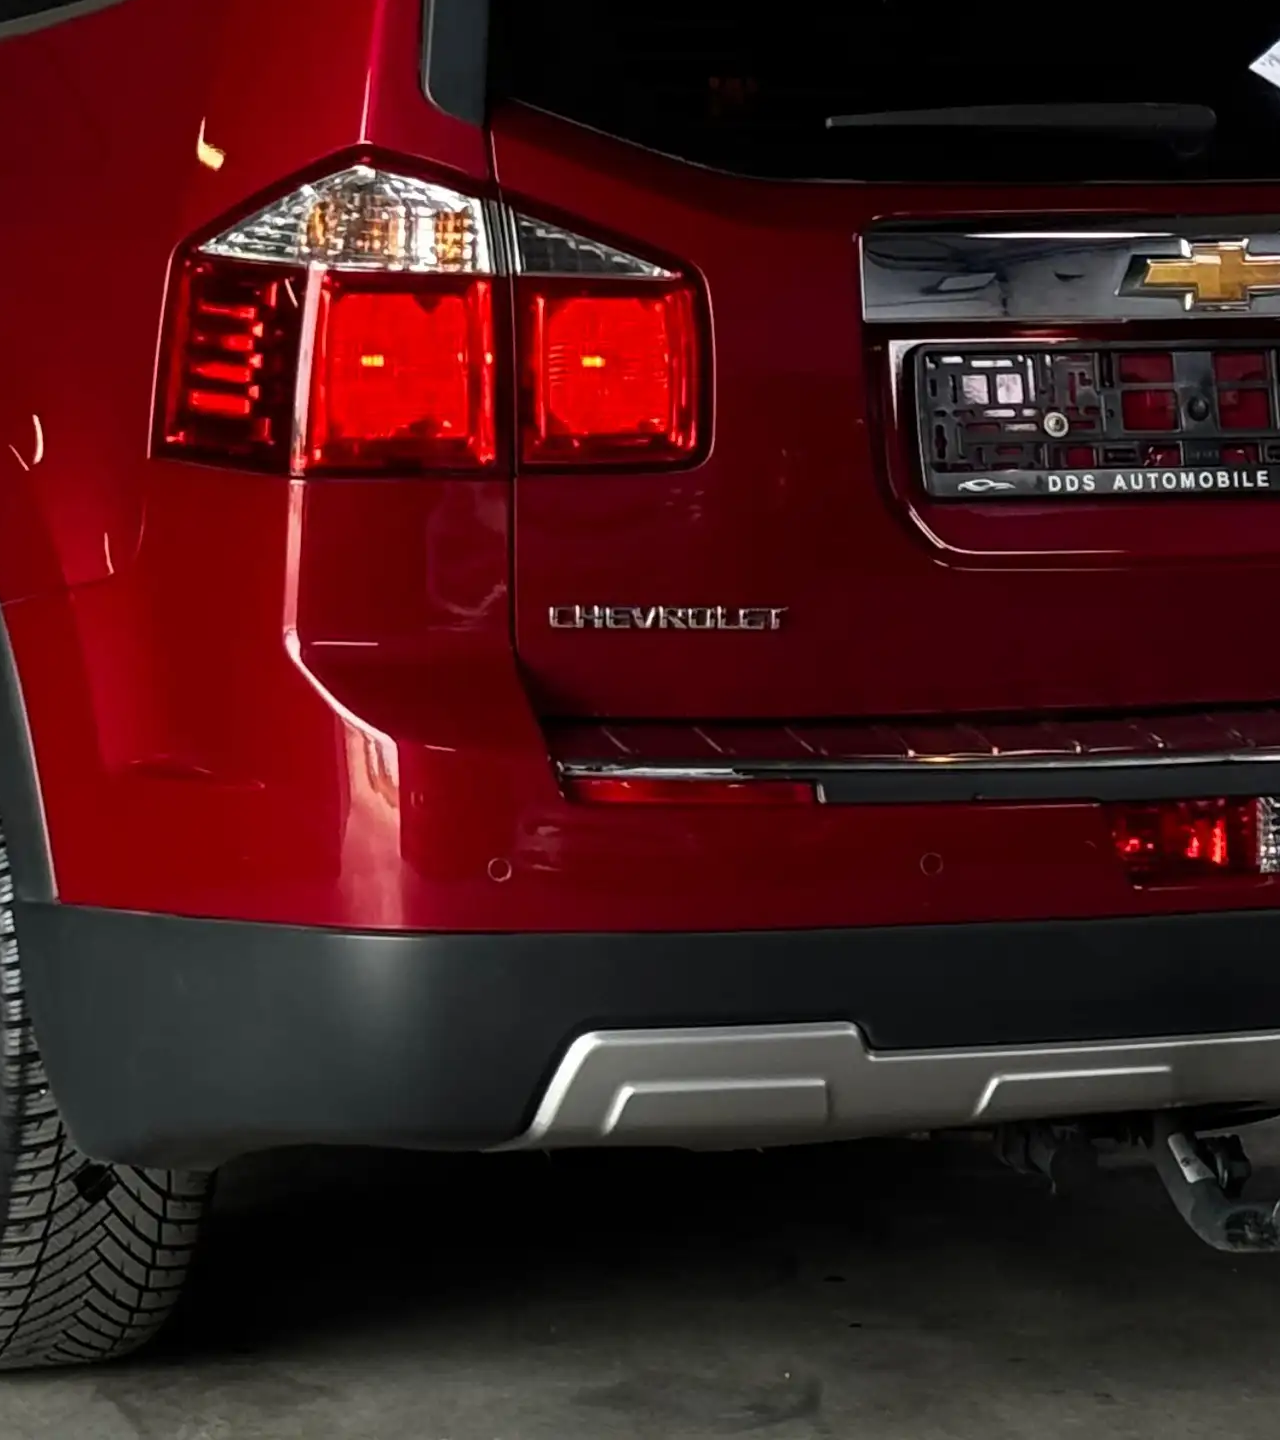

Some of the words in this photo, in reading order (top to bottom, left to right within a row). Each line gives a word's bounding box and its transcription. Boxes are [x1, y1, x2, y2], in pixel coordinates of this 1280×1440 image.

[1047, 474, 1096, 493] DDS
[1112, 468, 1270, 492] AUTOMOBILE
[548, 603, 788, 630] CHEVROLET
